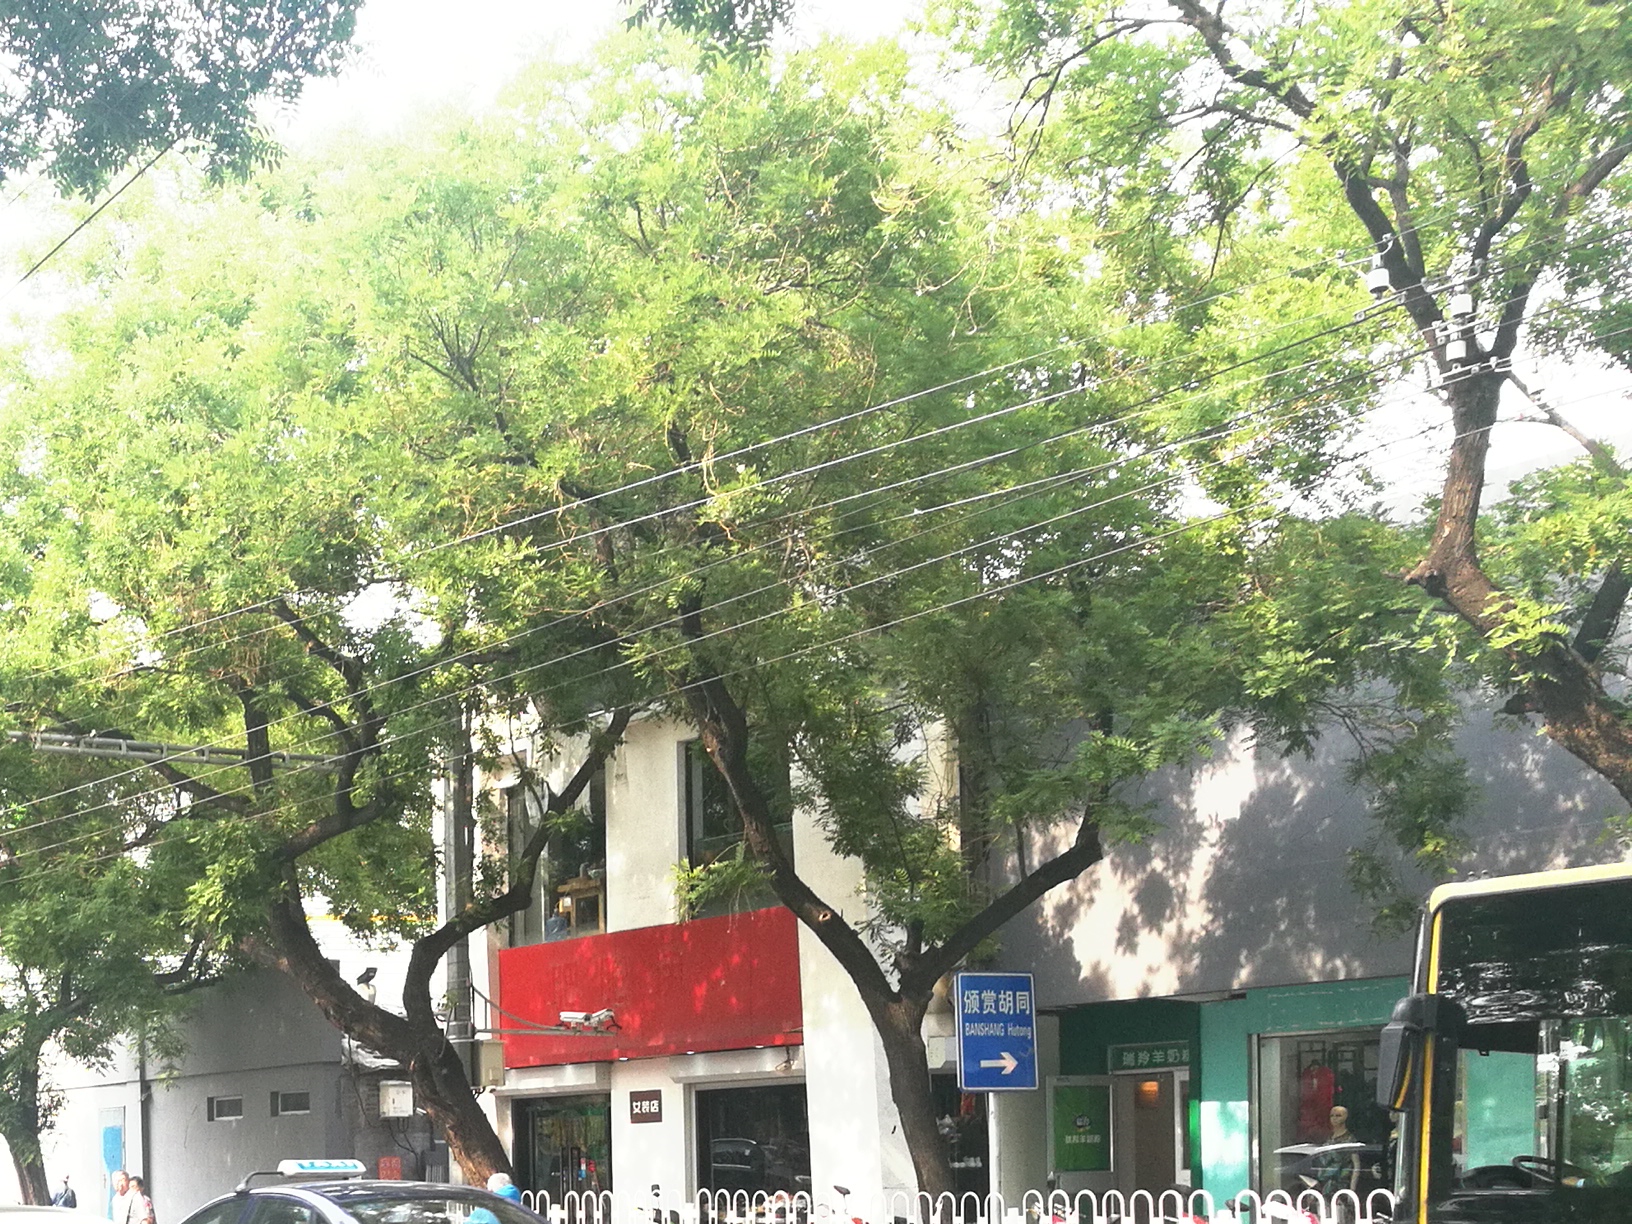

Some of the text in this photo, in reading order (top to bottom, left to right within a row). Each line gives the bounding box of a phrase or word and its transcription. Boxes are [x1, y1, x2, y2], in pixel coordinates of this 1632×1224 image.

[964, 990, 1030, 1015] 颁赏胡同
[965, 1023, 1032, 1039] BANSHANG Hutong
